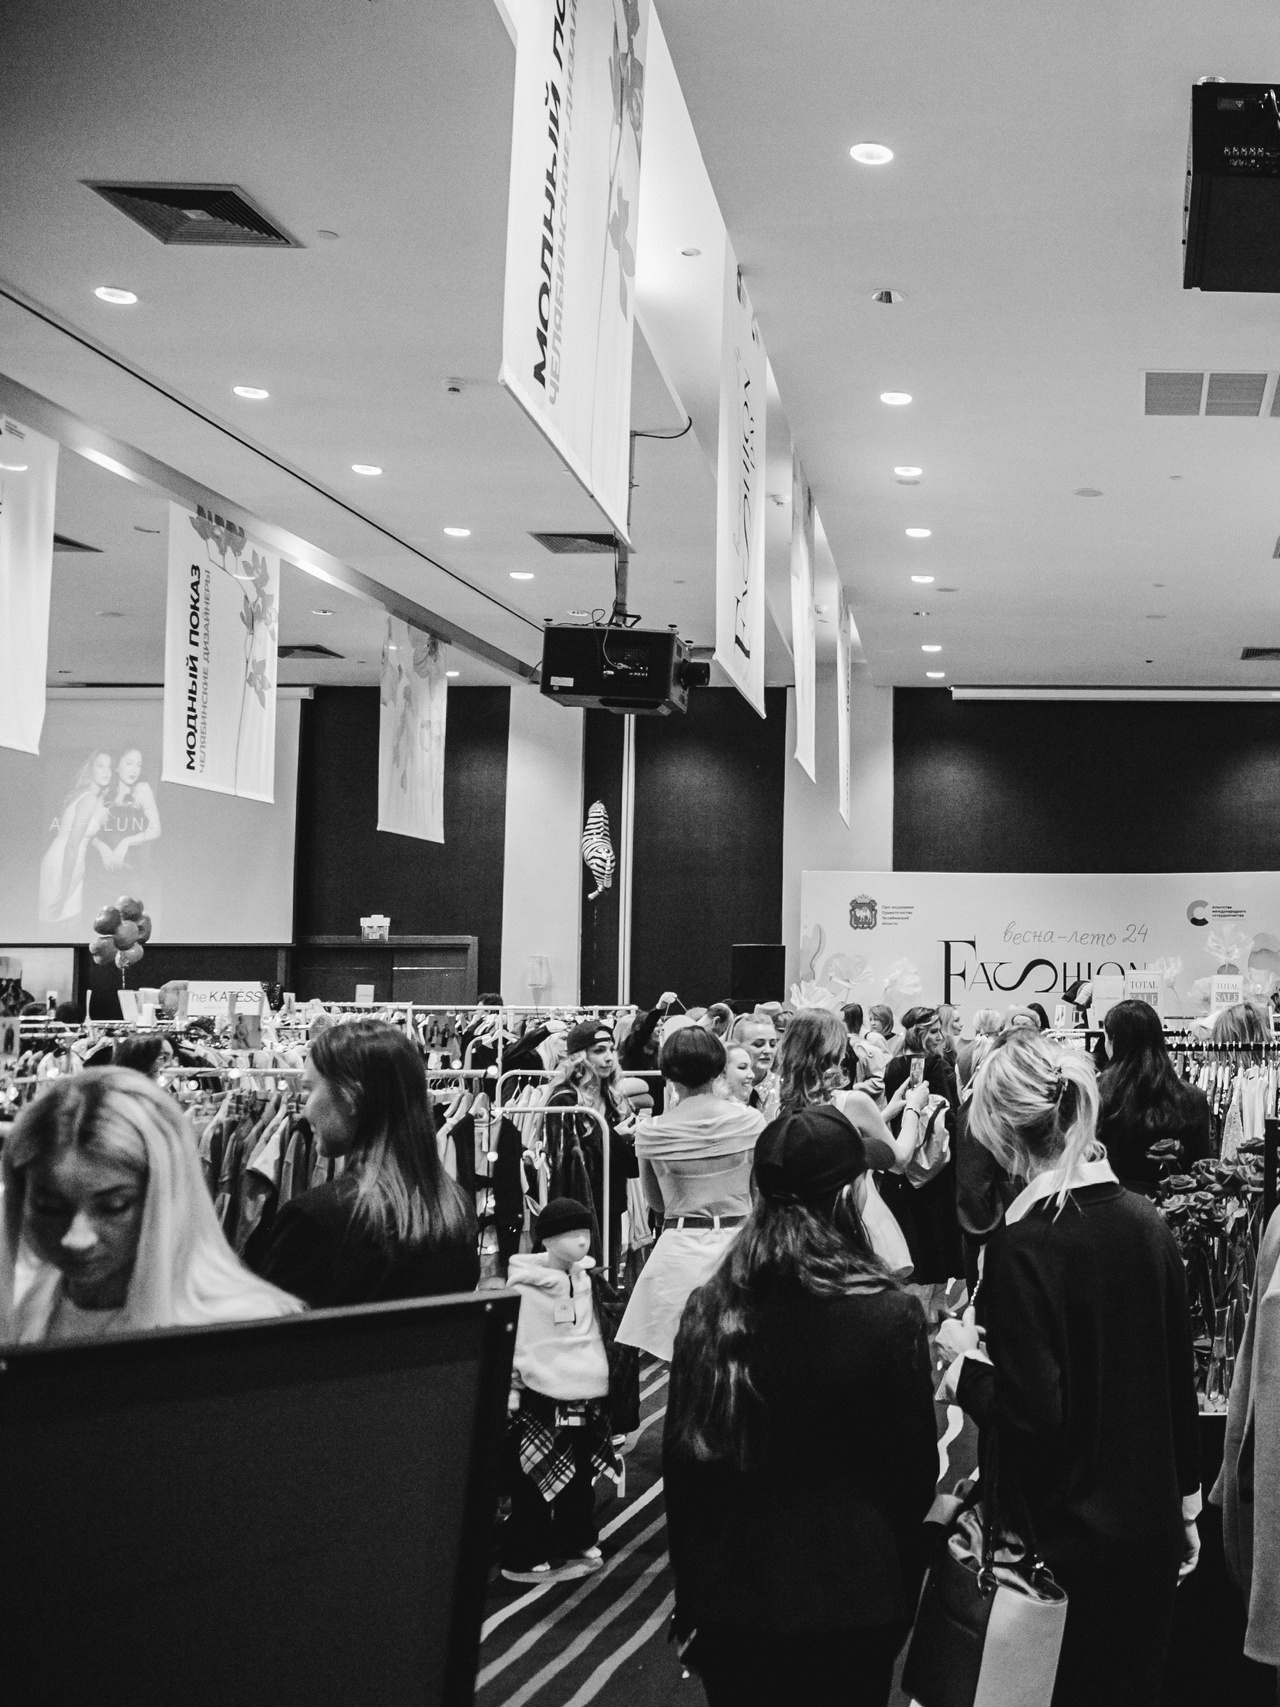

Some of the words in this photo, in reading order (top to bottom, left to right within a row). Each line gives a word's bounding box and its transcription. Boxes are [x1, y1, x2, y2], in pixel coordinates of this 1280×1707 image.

[533, 80, 561, 390] МОДНЫЙ
[189, 564, 201, 647] ПОКАЗ
[186, 655, 199, 770] МОДНЫЙ
[1003, 920, 1117, 946] весна-лето
[1122, 923, 1149, 944] 24
[937, 935, 1147, 1006] FASHI
[1130, 980, 1158, 989] TOTAL
[1216, 993, 1239, 1002] SALE
